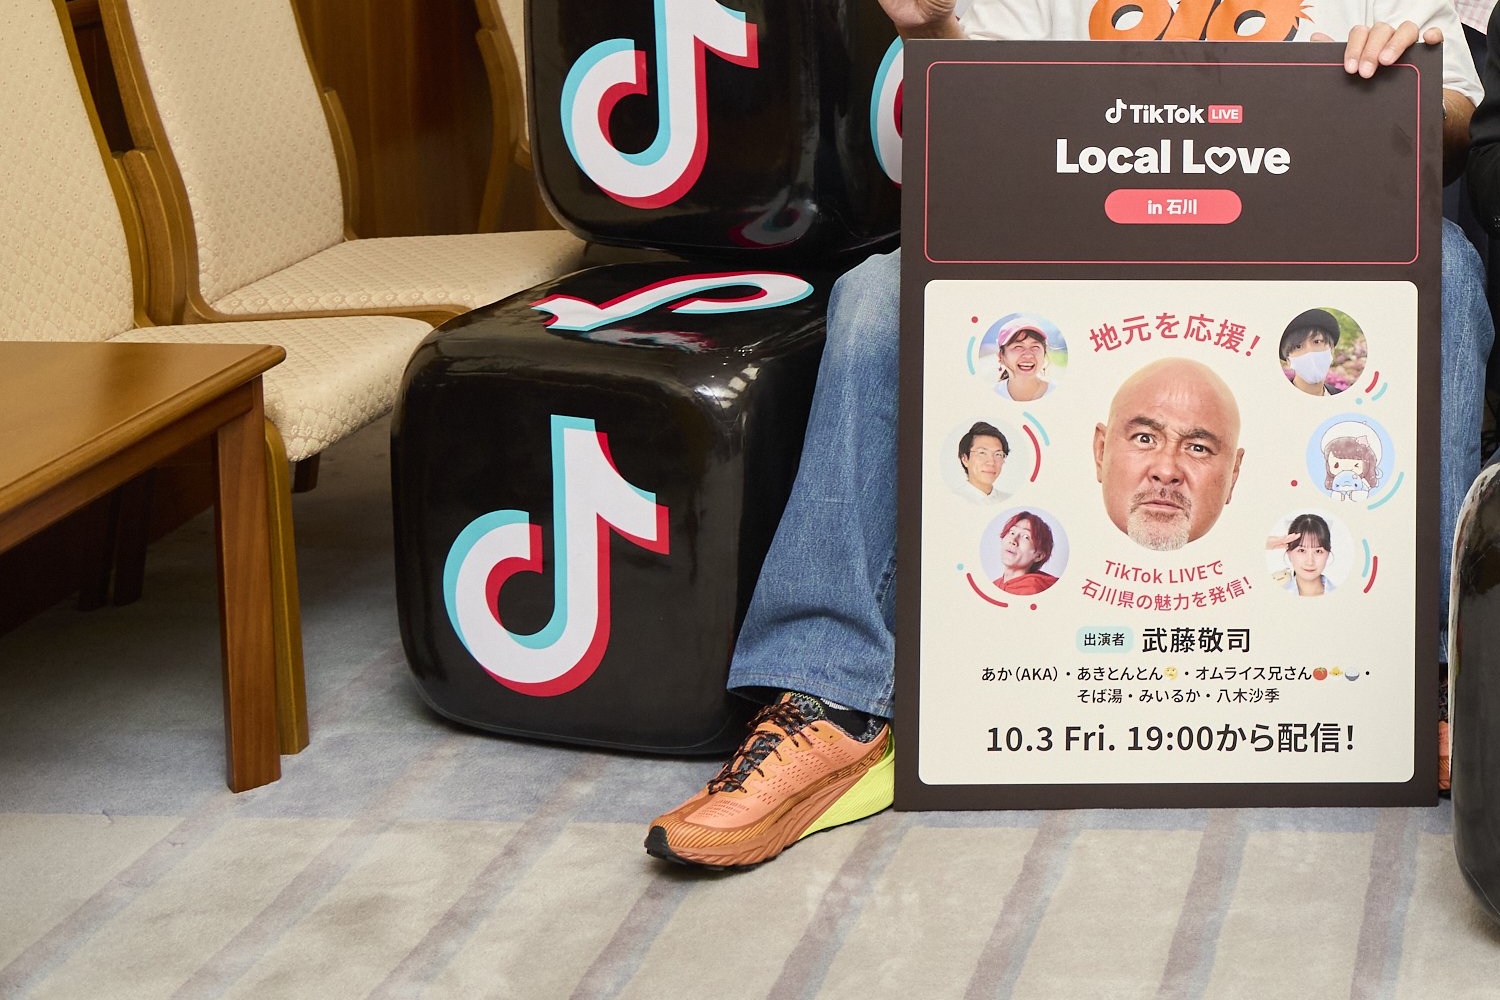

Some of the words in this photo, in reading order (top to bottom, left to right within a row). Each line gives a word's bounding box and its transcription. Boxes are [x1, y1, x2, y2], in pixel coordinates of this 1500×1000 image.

[1130, 105, 1205, 124] TikTok
[1211, 109, 1239, 120] LIVE
[1057, 139, 1171, 174] Local
[1147, 200, 1163, 214] in
[1166, 199, 1198, 215] 石川
[1089, 313, 1260, 356] 地元を応援！
[1106, 560, 1162, 584] TikTok
[1168, 560, 1224, 585] LIVEで
[1081, 576, 1252, 611] 石川県の魅力を発信！
[1084, 632, 1125, 647] 出演者
[1142, 627, 1250, 654] 武藤敬司
[986, 726, 1053, 752] 10.3
[1065, 723, 1115, 752] Fri.
[1127, 722, 1354, 753] 19:00から配信！
